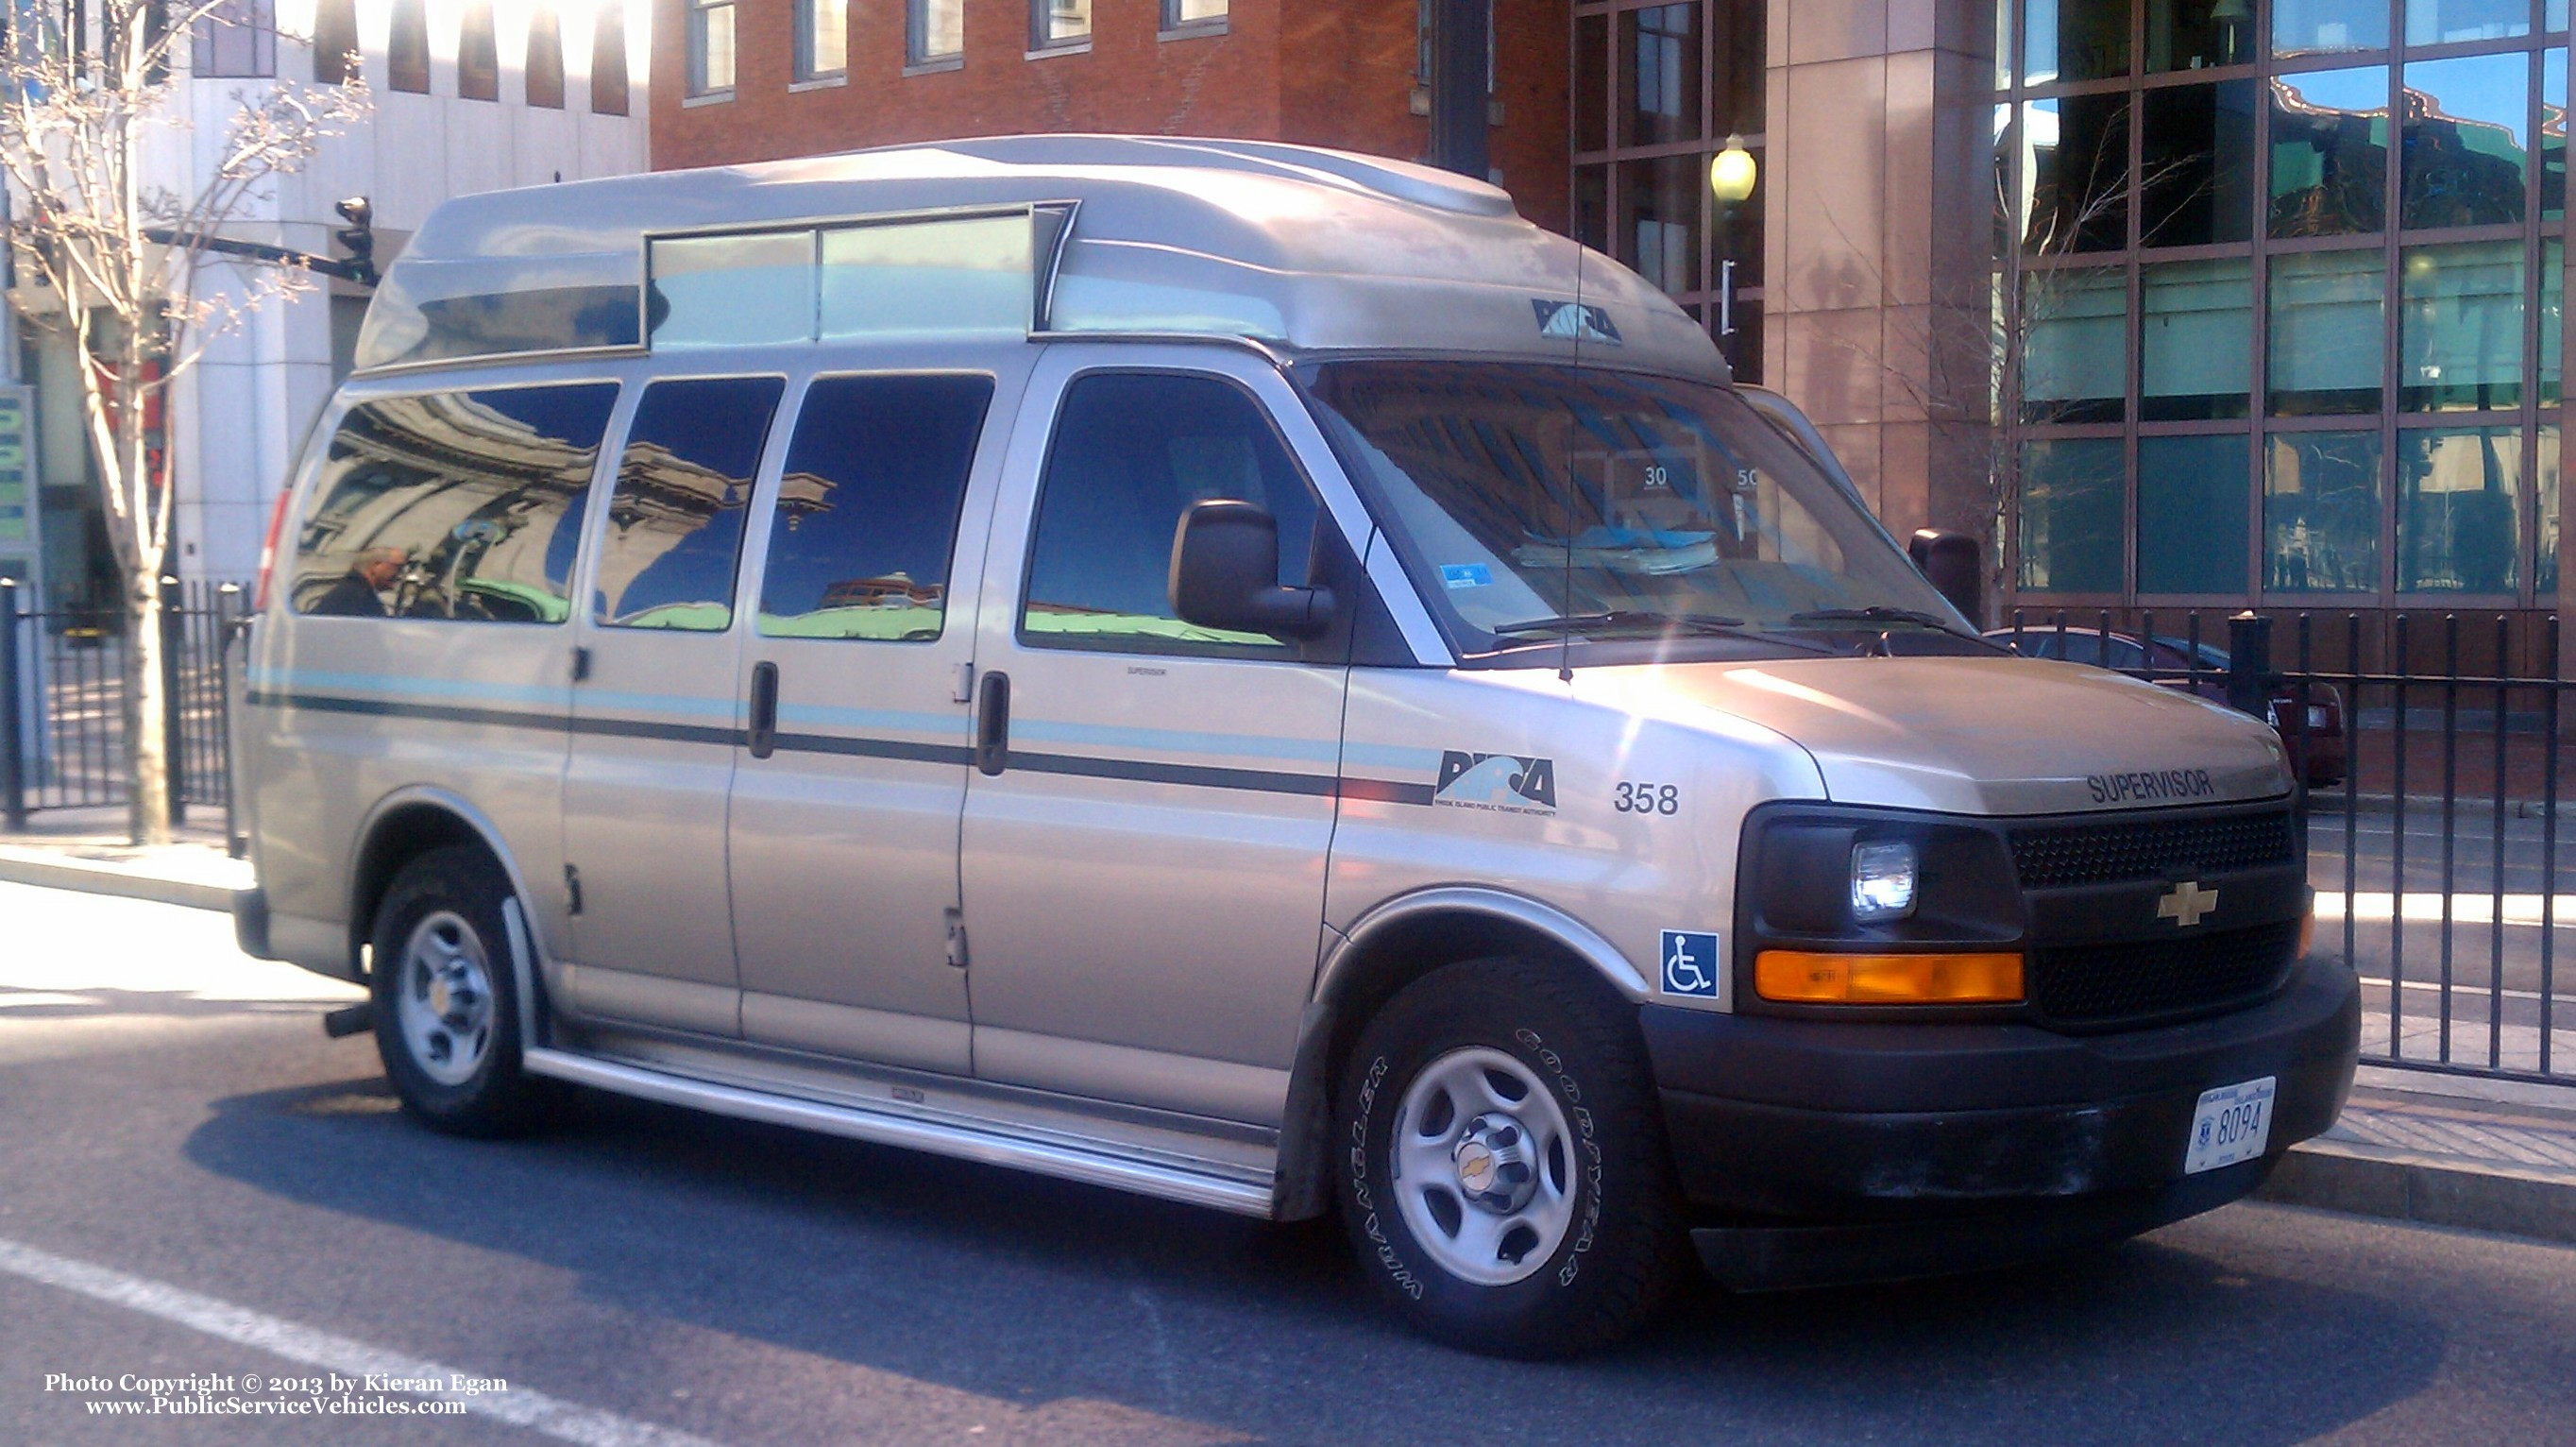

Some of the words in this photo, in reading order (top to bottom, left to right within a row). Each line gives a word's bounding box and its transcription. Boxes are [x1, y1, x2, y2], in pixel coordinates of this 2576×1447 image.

[1645, 467, 1667, 485] 30
[1614, 781, 1678, 815] 358
[2087, 769, 2214, 803] SUPERVISOR
[2217, 1100, 2262, 1146] 8094
[1516, 1028, 1602, 1287] GOODYEAR
[1350, 1055, 1424, 1301] WRANGLER
